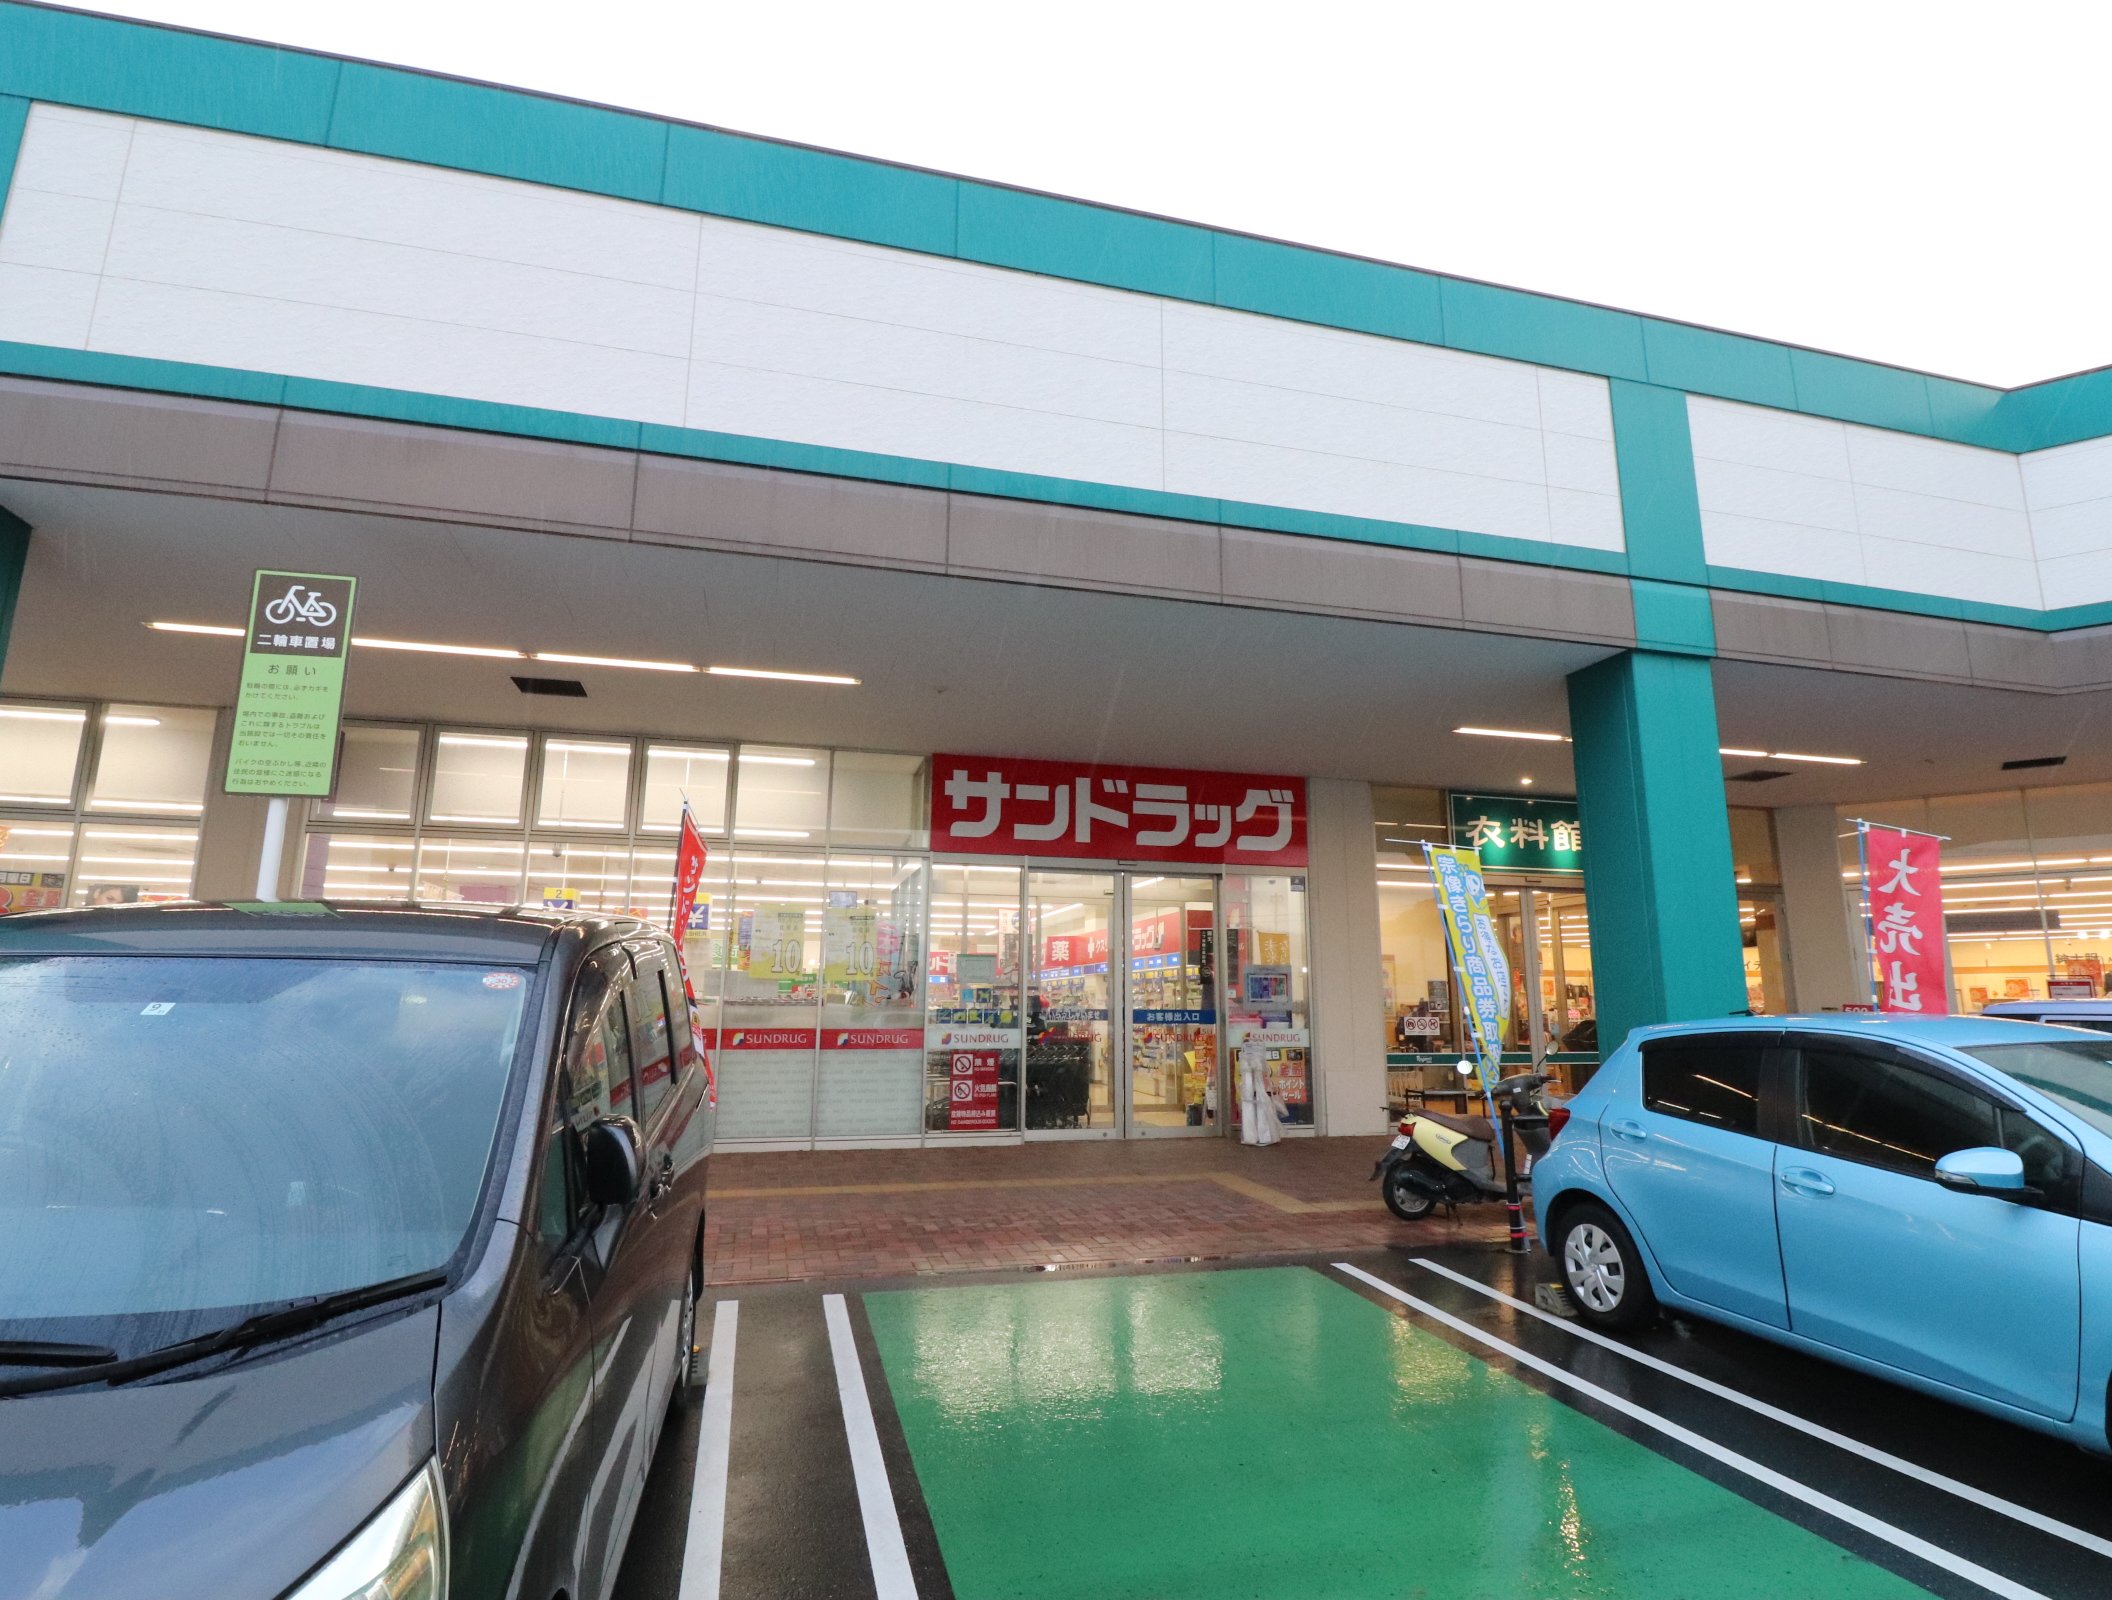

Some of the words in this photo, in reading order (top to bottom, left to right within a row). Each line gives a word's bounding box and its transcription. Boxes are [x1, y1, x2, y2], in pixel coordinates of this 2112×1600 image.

[256, 634, 337, 650] 二輪車置場
[267, 664, 317, 676] お願い
[945, 769, 1295, 852] サンドラッグ
[1465, 815, 1582, 852] 衣料館
[771, 939, 800, 974] 10
[1051, 940, 1070, 962] 薬
[846, 941, 875, 976] 10
[1146, 1012, 1200, 1021] お客様出入口
[746, 1034, 807, 1044] SUNDRUG
[850, 1034, 909, 1044] SUNDRUG
[954, 1033, 1009, 1044] SUNDRUG
[1252, 1033, 1301, 1042] SUNDRUG
[1278, 1079, 1305, 1090] ポイント
[1282, 1091, 1301, 1101] セール
